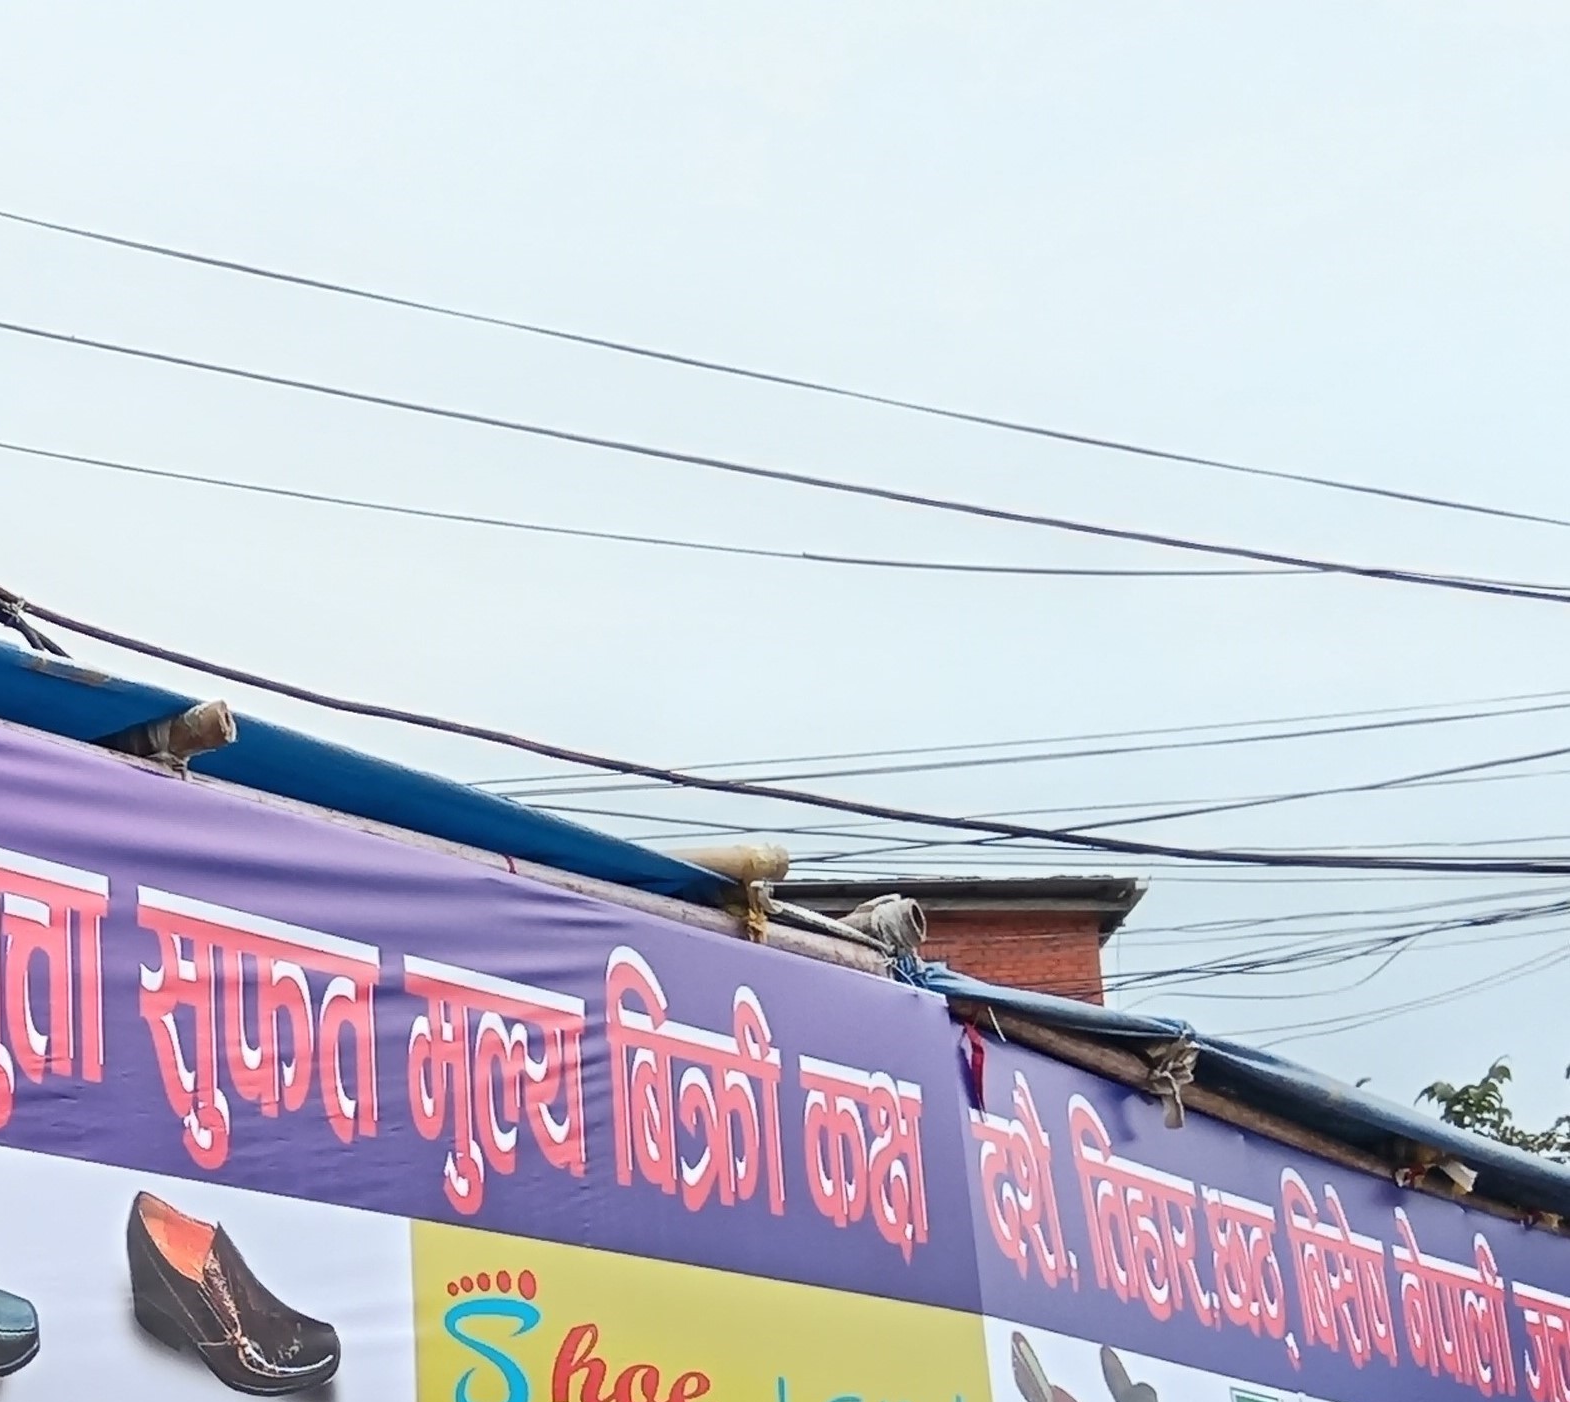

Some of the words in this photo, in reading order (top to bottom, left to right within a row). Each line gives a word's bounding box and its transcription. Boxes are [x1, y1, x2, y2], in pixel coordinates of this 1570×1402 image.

[137, 885, 381, 1169] सुफत
[403, 954, 587, 1215] मुल्य
[605, 945, 786, 1217] बिक्री
[799, 1054, 929, 1267] कक्ष
[1280, 1168, 1399, 1368] बिसेष
[1392, 1207, 1517, 1397] नेपाली
